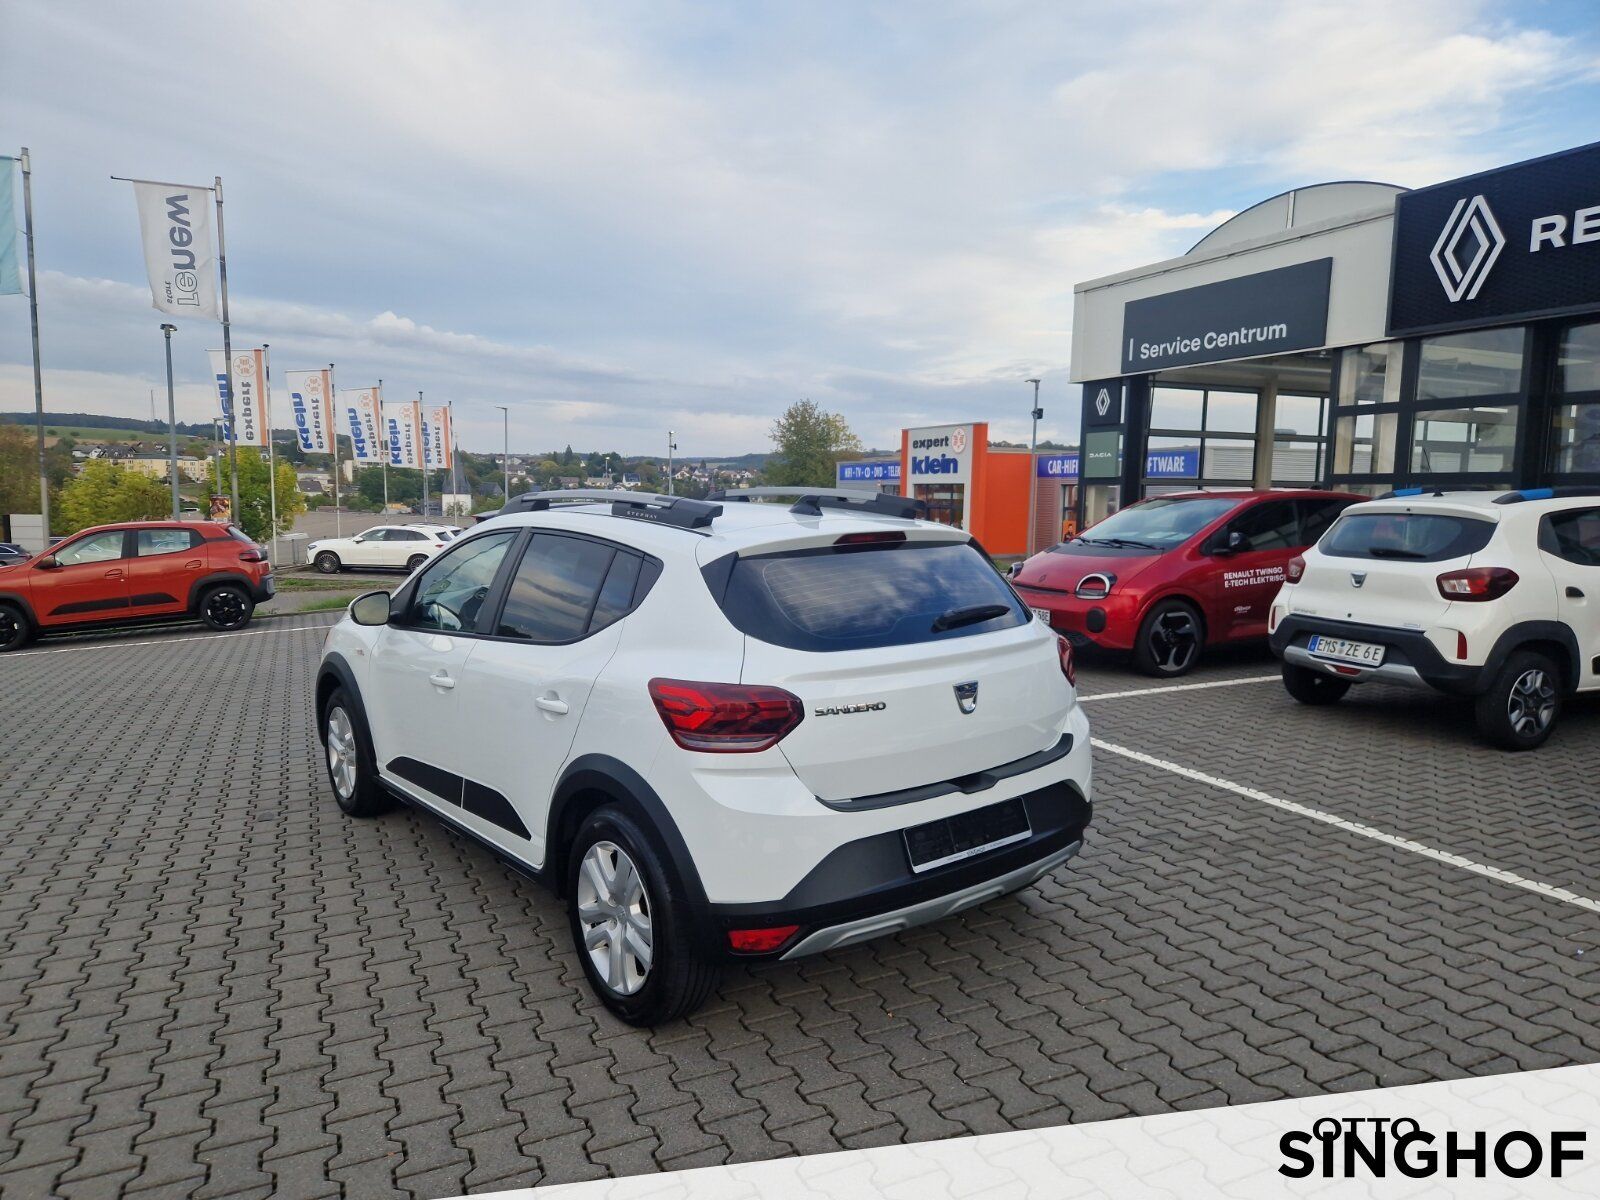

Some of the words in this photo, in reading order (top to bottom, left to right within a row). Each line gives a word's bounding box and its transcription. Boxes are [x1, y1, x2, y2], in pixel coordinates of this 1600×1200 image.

[1529, 205, 1600, 253] RE
[1140, 336, 1201, 360] Service
[1203, 323, 1288, 350] Centrum
[912, 435, 950, 450] expert
[911, 453, 959, 475] klein
[1223, 569, 1254, 580] RENAULT
[1255, 566, 1283, 577] TWINGO
[1224, 579, 1249, 588] E-TECH
[1317, 638, 1338, 654] EMS
[1345, 643, 1361, 658] ZE
[814, 701, 887, 717] SANDERO
